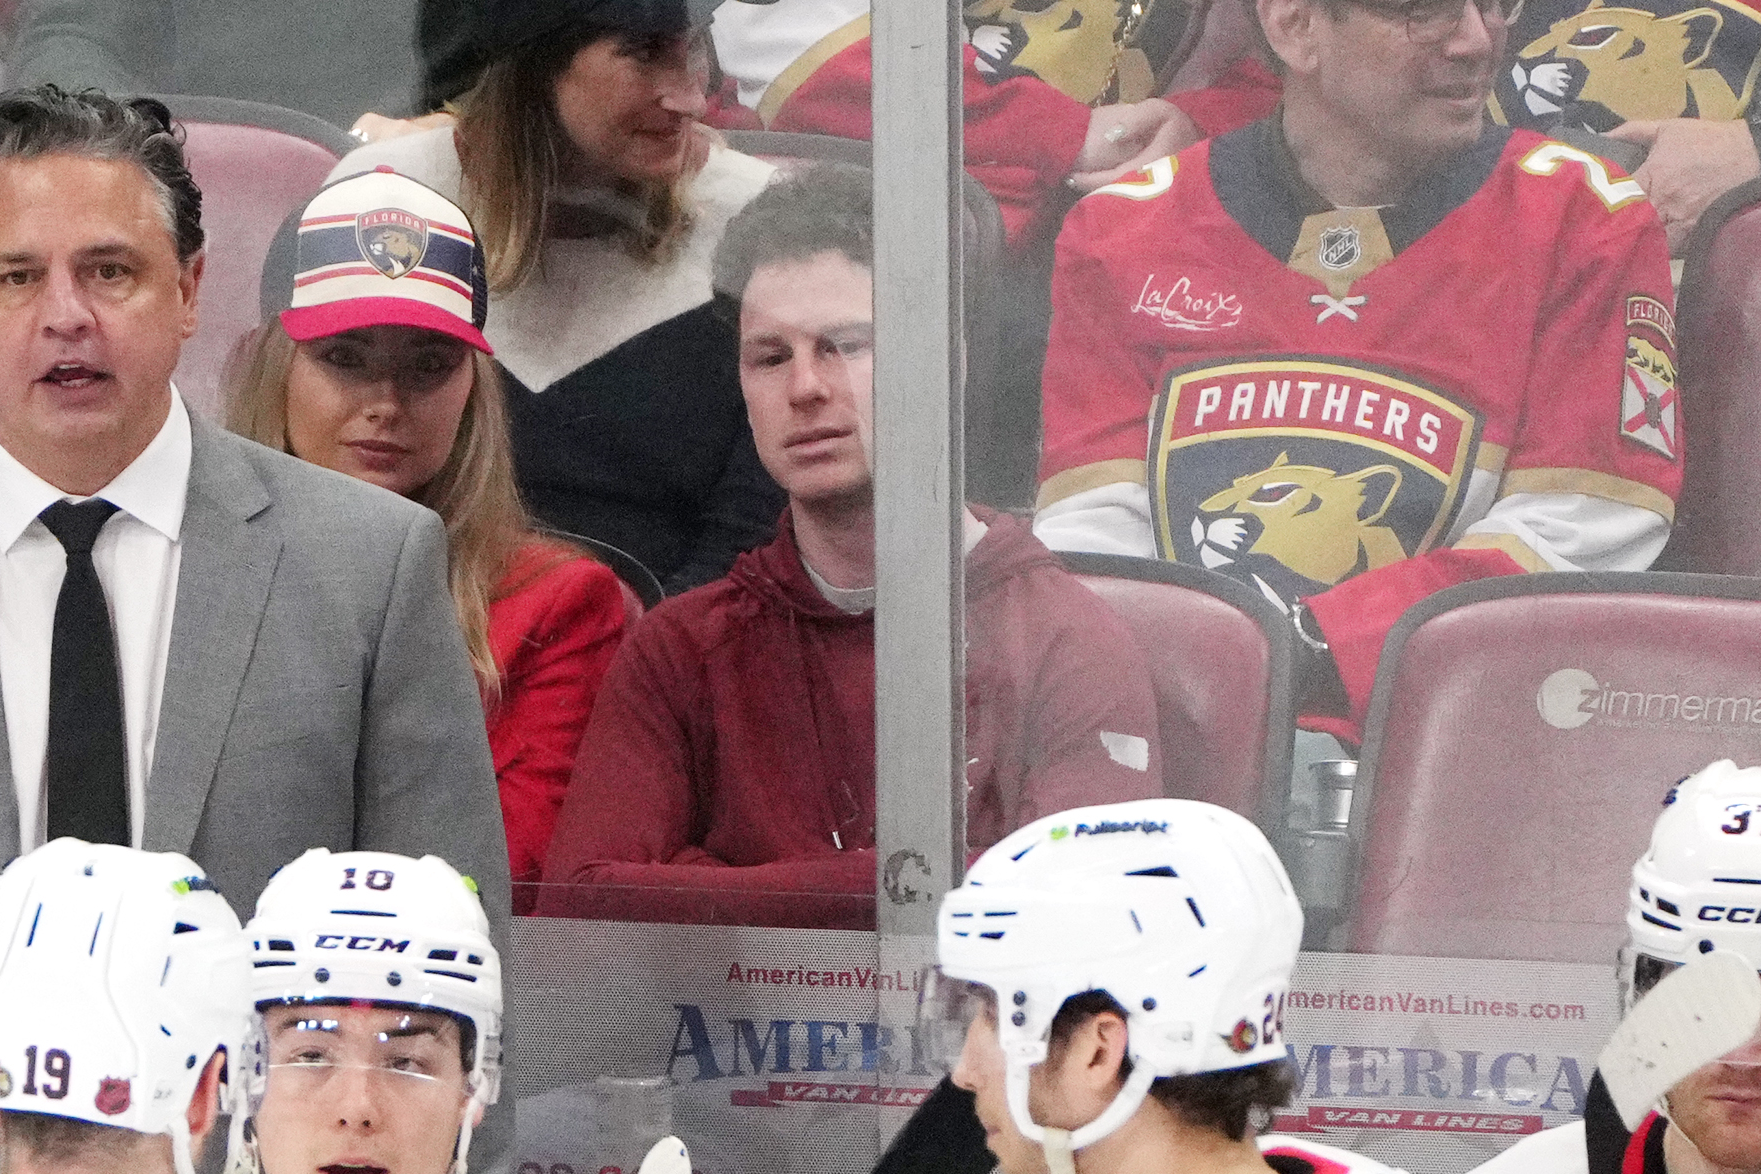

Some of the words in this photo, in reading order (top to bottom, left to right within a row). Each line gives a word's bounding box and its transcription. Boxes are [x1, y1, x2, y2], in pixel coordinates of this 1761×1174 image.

[364, 212, 420, 229] FLORIDA
[1131, 273, 1243, 320] LaCroix
[1194, 380, 1444, 456] PANTHERS
[315, 934, 412, 953] CCM
[1288, 988, 1585, 1020] mericanVanLines.com
[23, 1045, 71, 1100] 19
